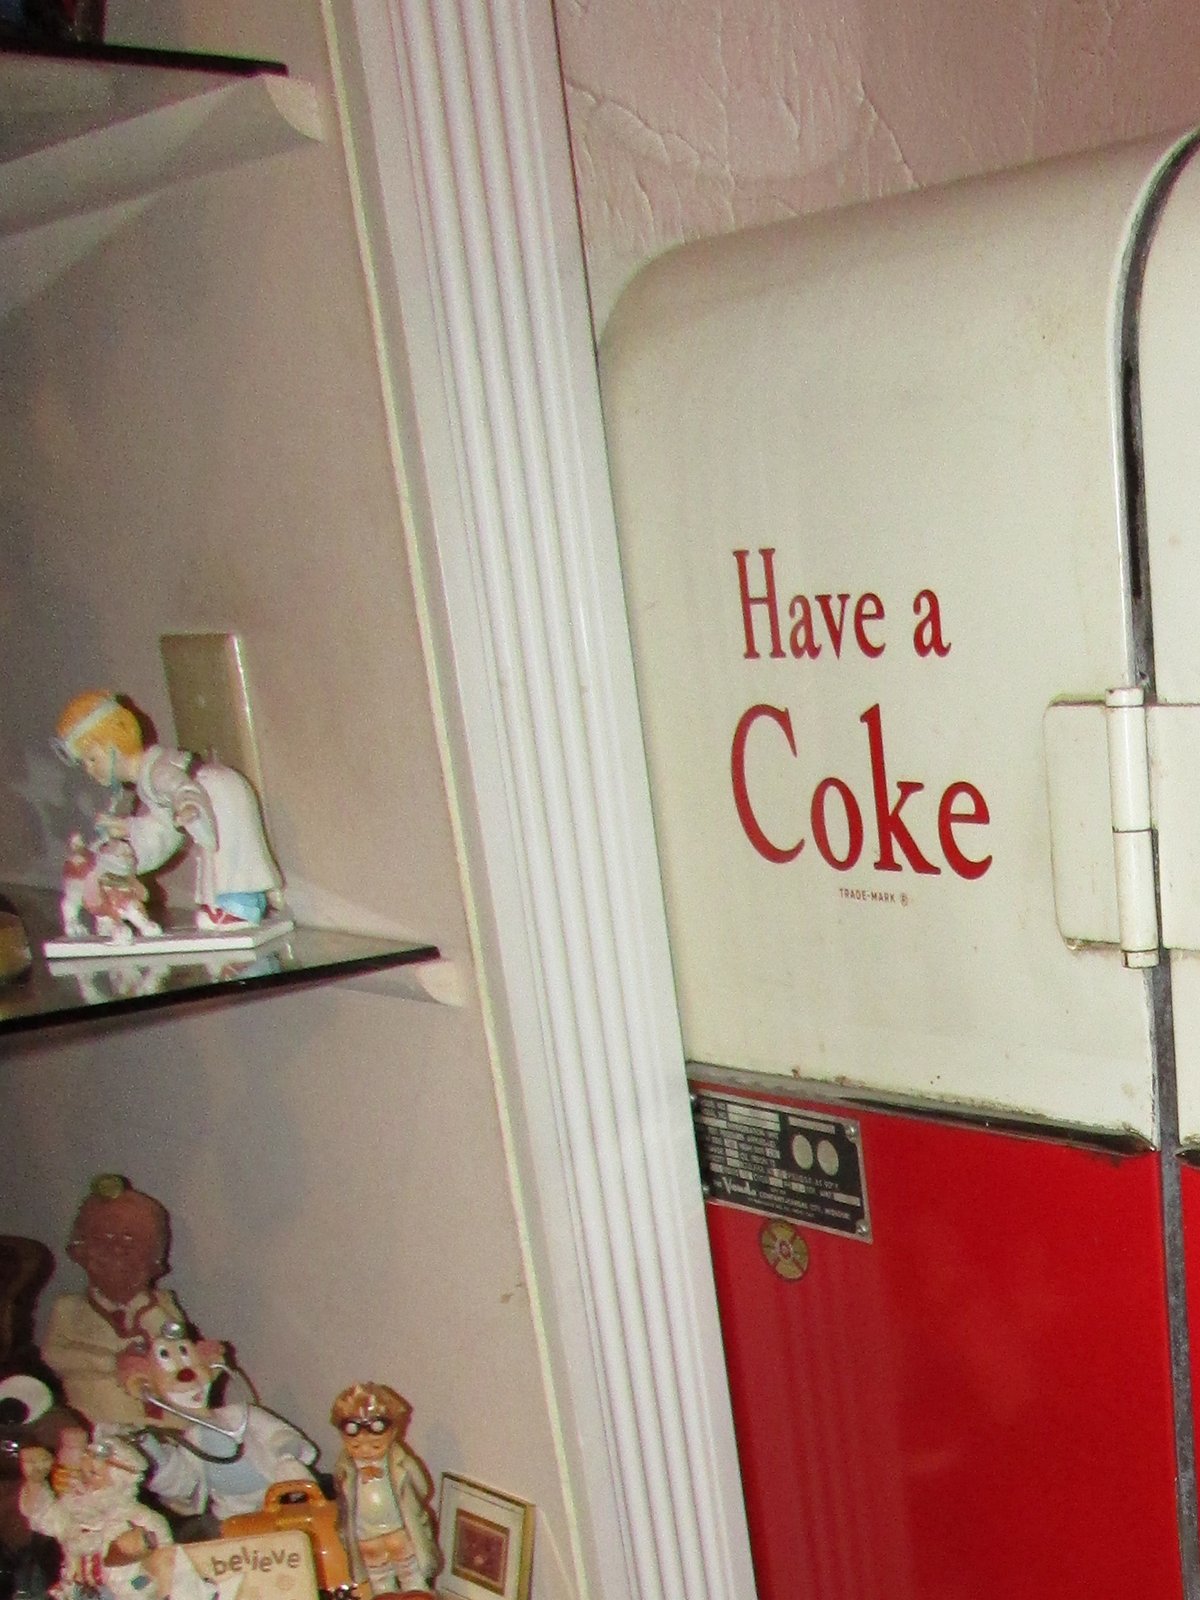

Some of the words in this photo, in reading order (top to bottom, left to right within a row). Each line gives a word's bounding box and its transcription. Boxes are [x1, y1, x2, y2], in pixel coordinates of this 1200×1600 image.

[733, 548, 887, 660] Have
[913, 588, 952, 658] a
[731, 703, 993, 880] Coke
[211, 1547, 300, 1576] believe
